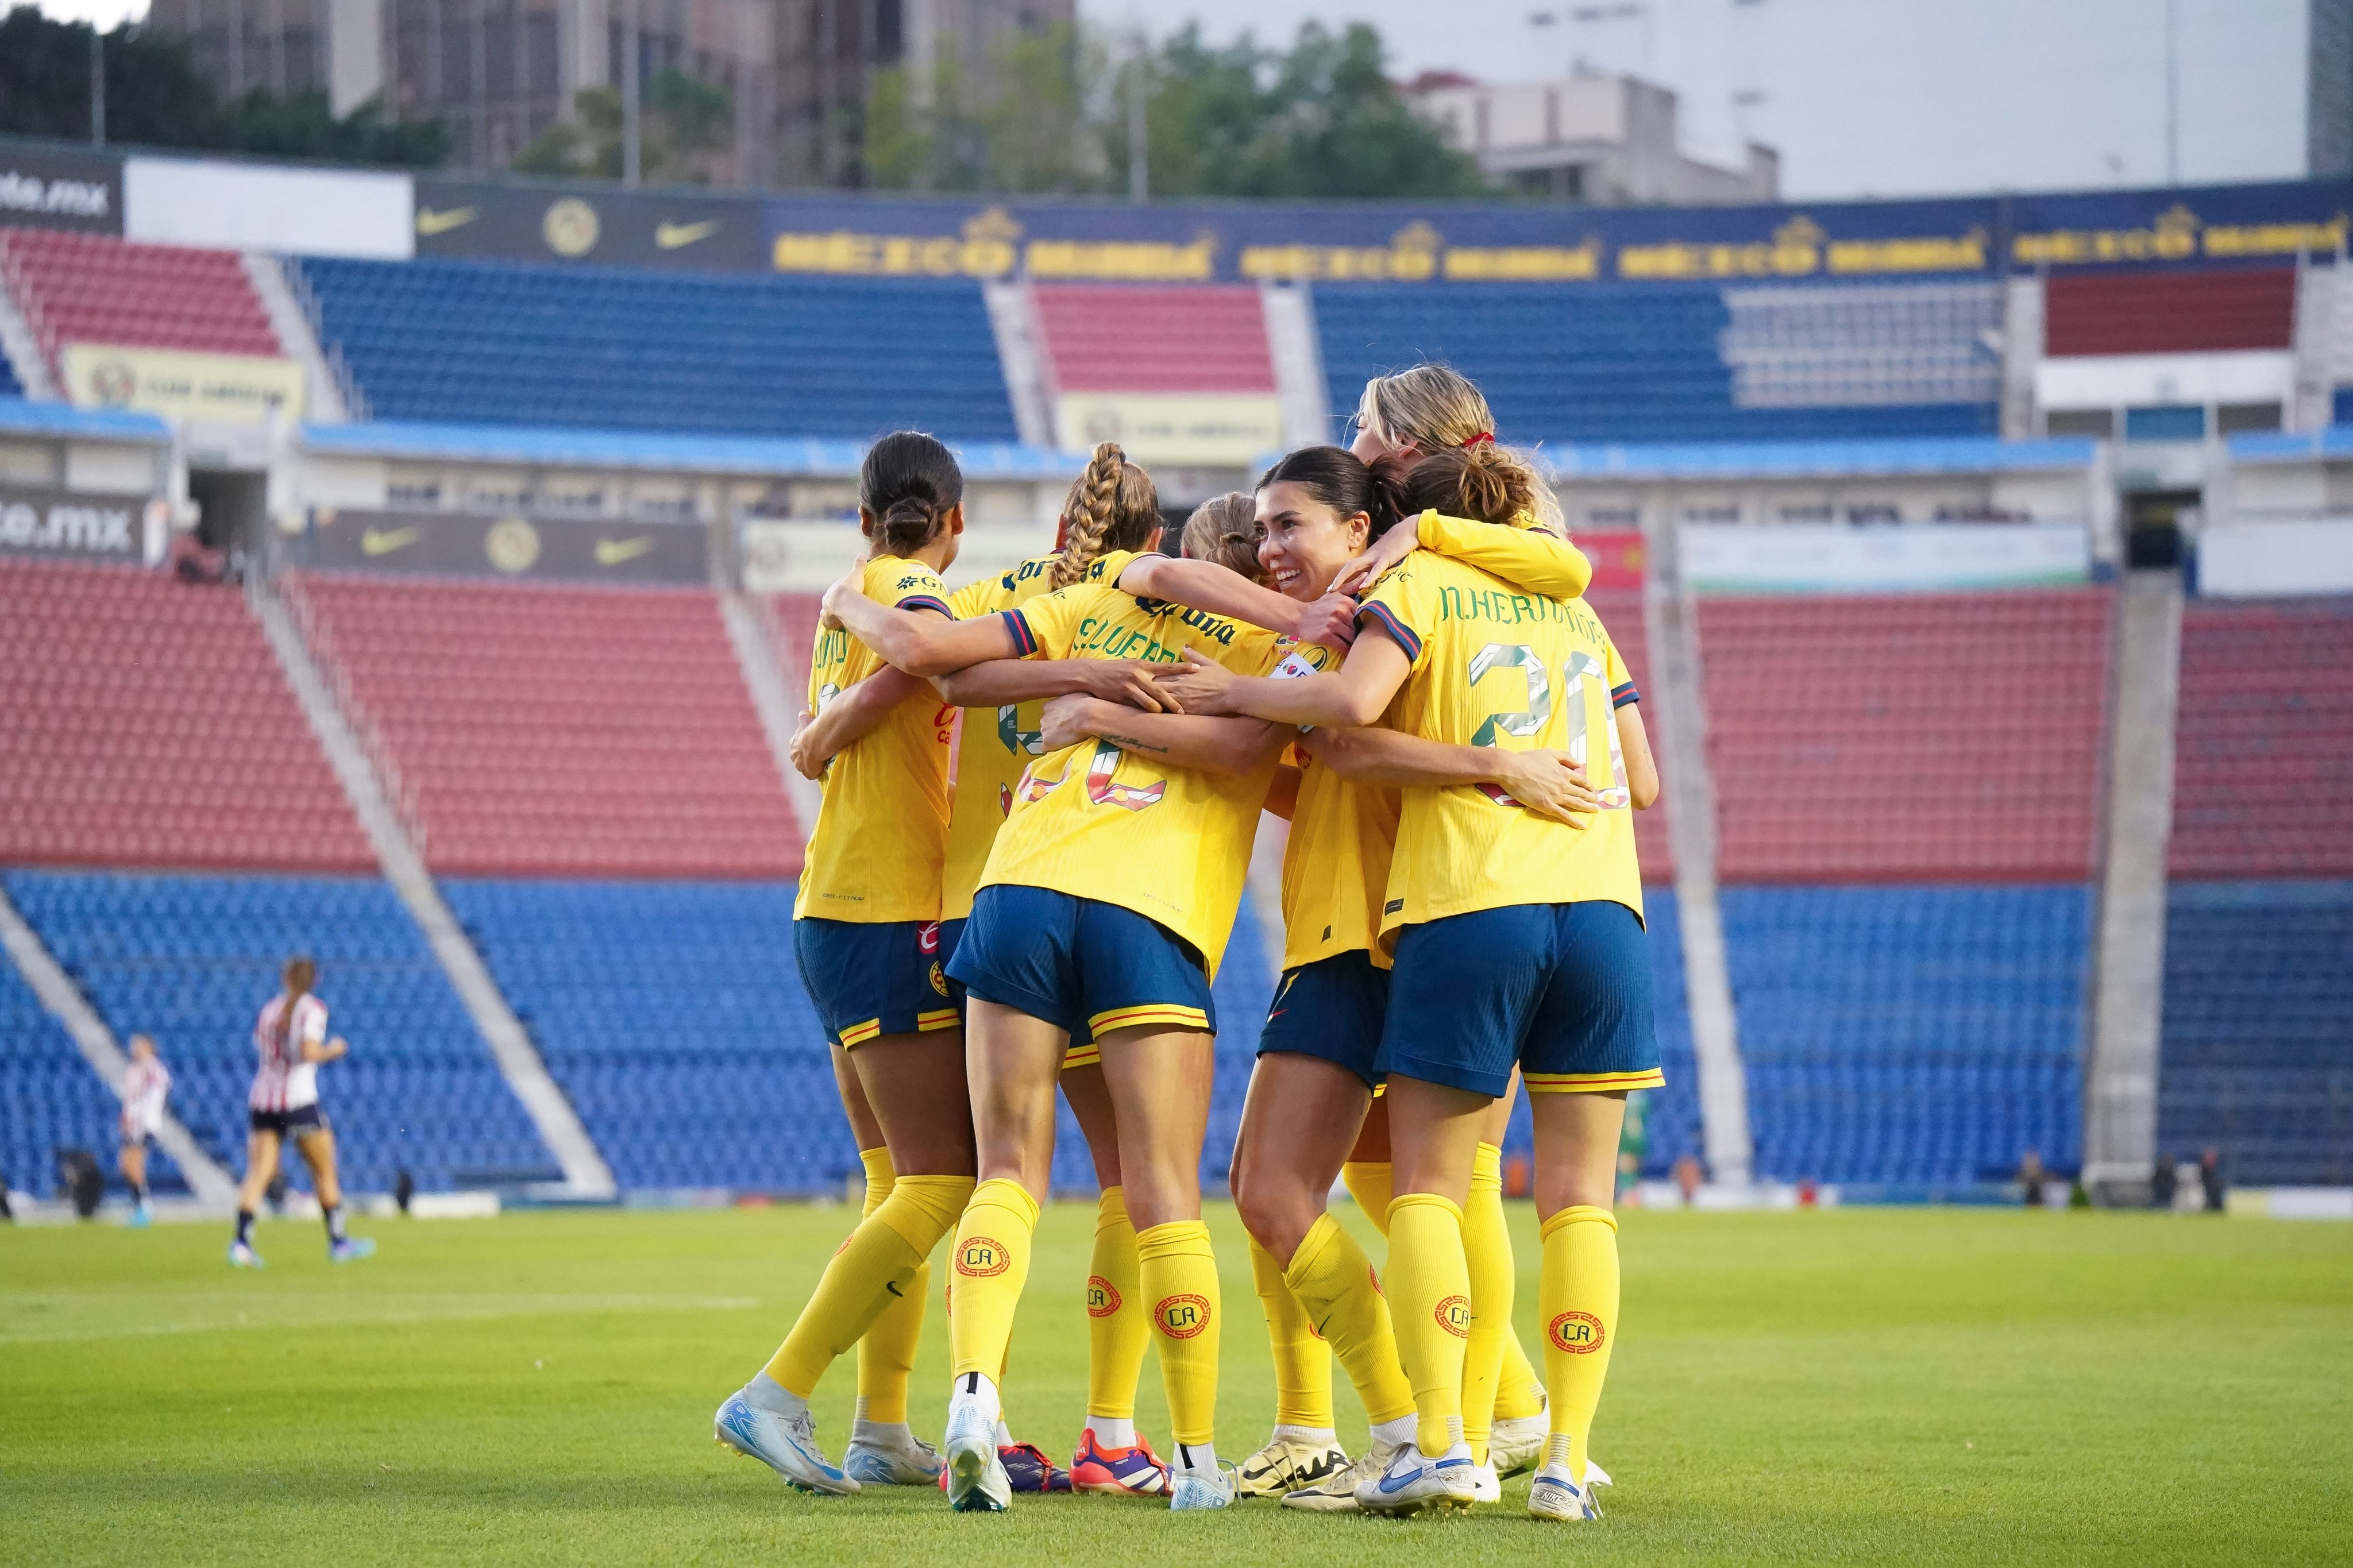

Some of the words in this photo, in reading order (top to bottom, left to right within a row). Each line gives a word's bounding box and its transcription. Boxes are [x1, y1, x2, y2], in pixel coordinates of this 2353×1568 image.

[921, 576, 948, 597] GN
[1468, 643, 1630, 810] 20
[966, 1249, 993, 1266] CA
[1168, 1307, 1198, 1327] CA
[1563, 1323, 1591, 1343] CA
[1541, 1492, 1563, 1505] NIKE
